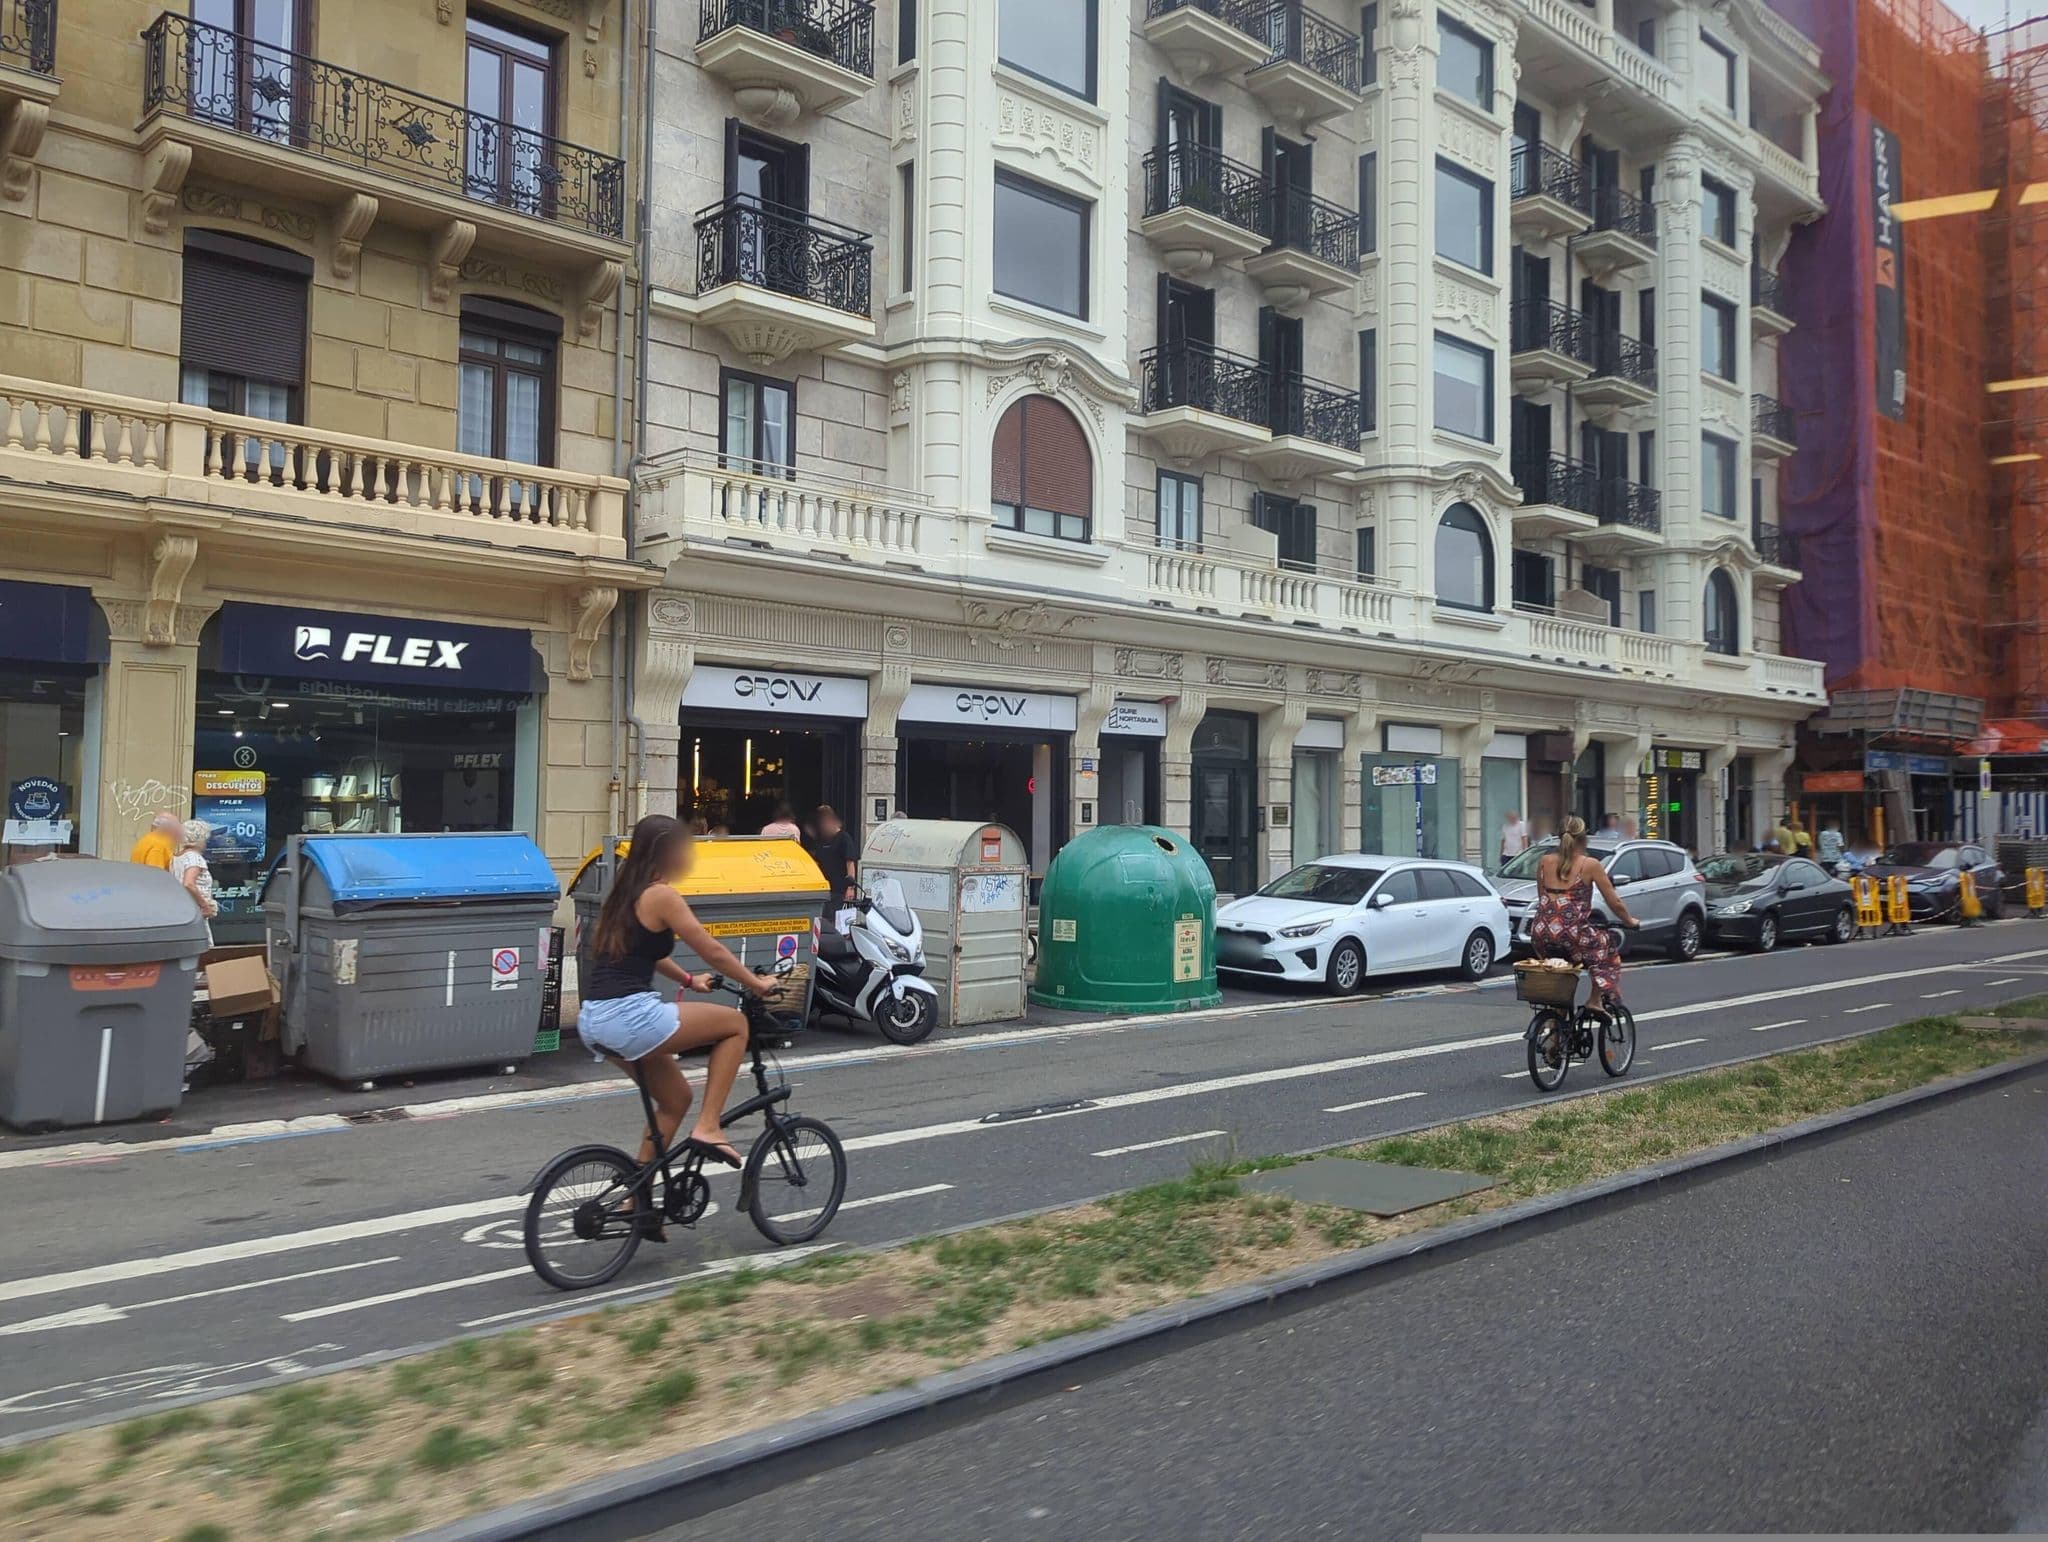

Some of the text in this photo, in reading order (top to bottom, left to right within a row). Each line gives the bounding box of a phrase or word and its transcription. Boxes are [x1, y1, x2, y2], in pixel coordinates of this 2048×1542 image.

[341, 632, 470, 670] FLEX
[734, 675, 823, 707] GRONX
[955, 693, 1027, 721] GRONX
[463, 753, 502, 769] FLEX
[18, 780, 58, 793] NOVEDAD
[206, 782, 262, 790] DESCUENTOS
